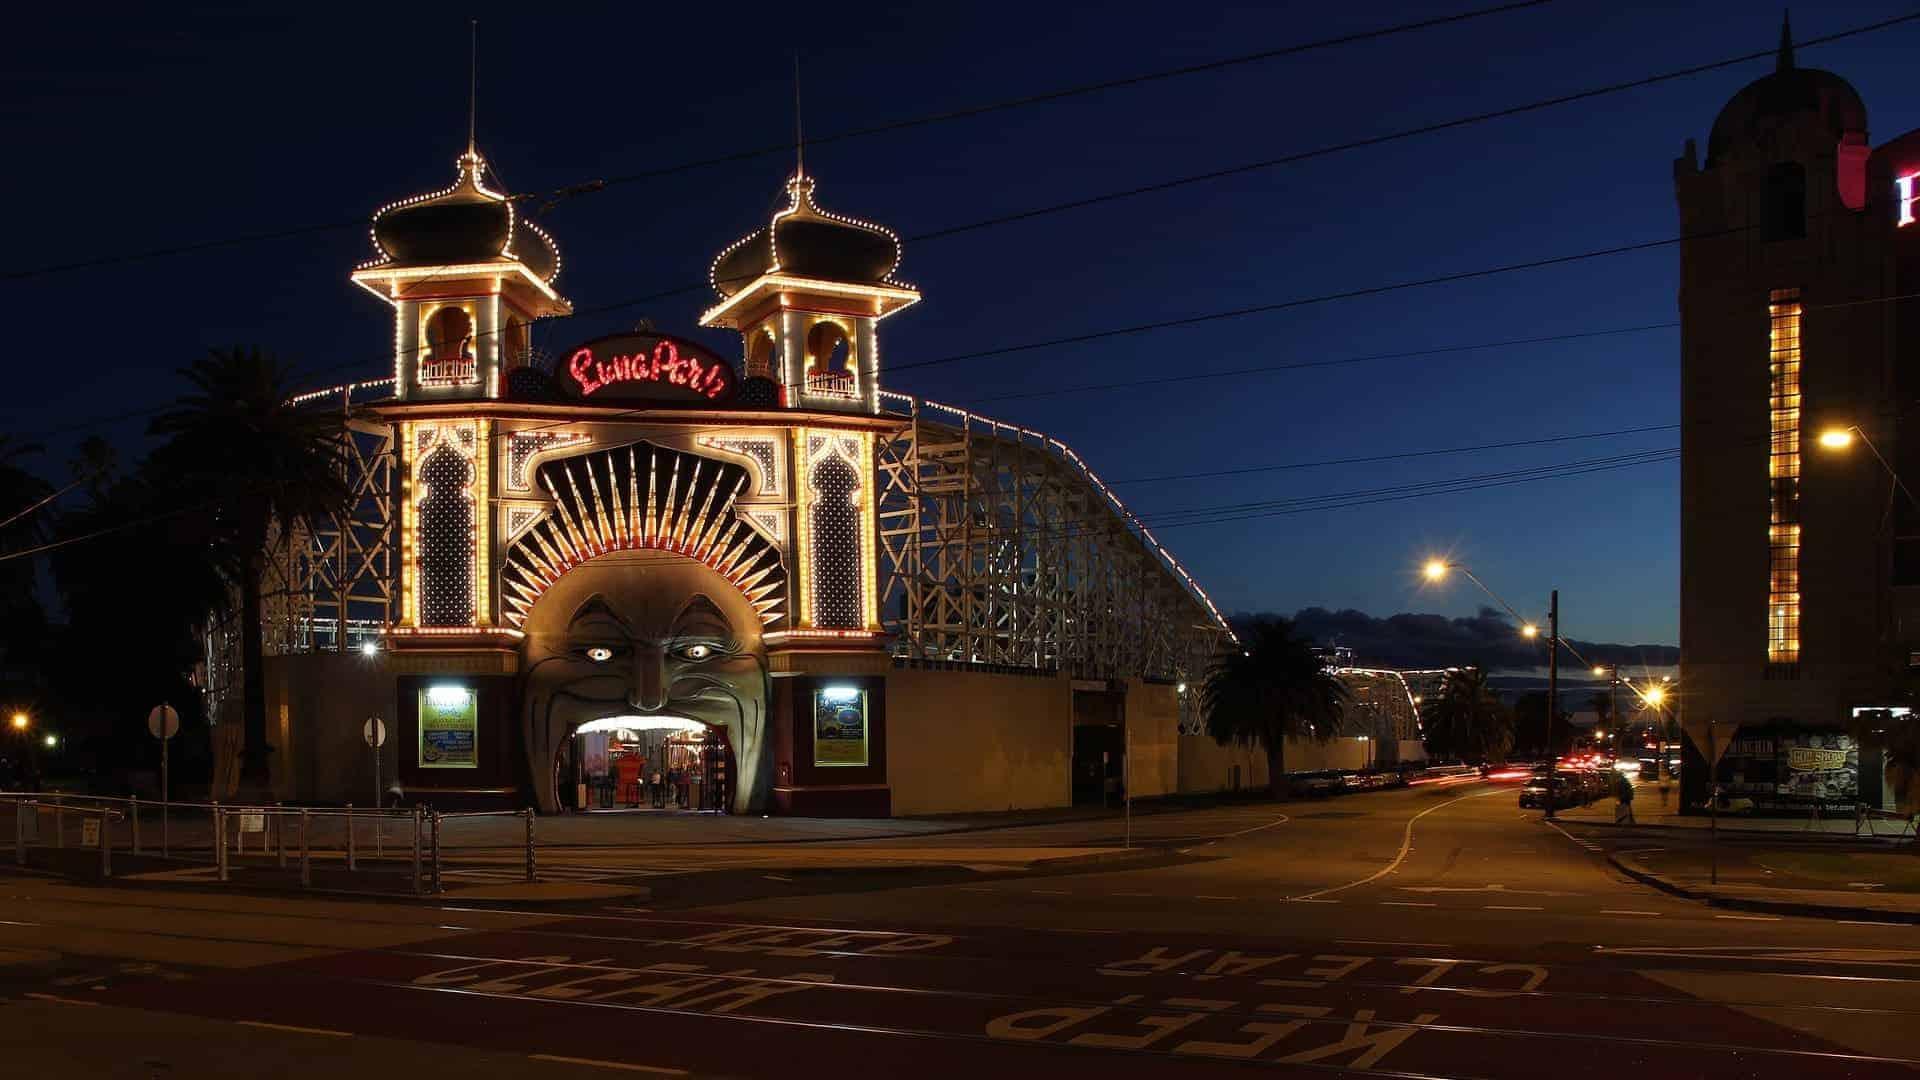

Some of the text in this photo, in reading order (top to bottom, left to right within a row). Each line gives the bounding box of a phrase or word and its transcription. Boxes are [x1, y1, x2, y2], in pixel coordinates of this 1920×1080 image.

[570, 340, 725, 398] Luna Park
[643, 927, 953, 956] KEEP
[413, 955, 834, 1012] CLEAR
[1096, 947, 1550, 997] CLEAR
[985, 994, 1441, 1071] KEEP
